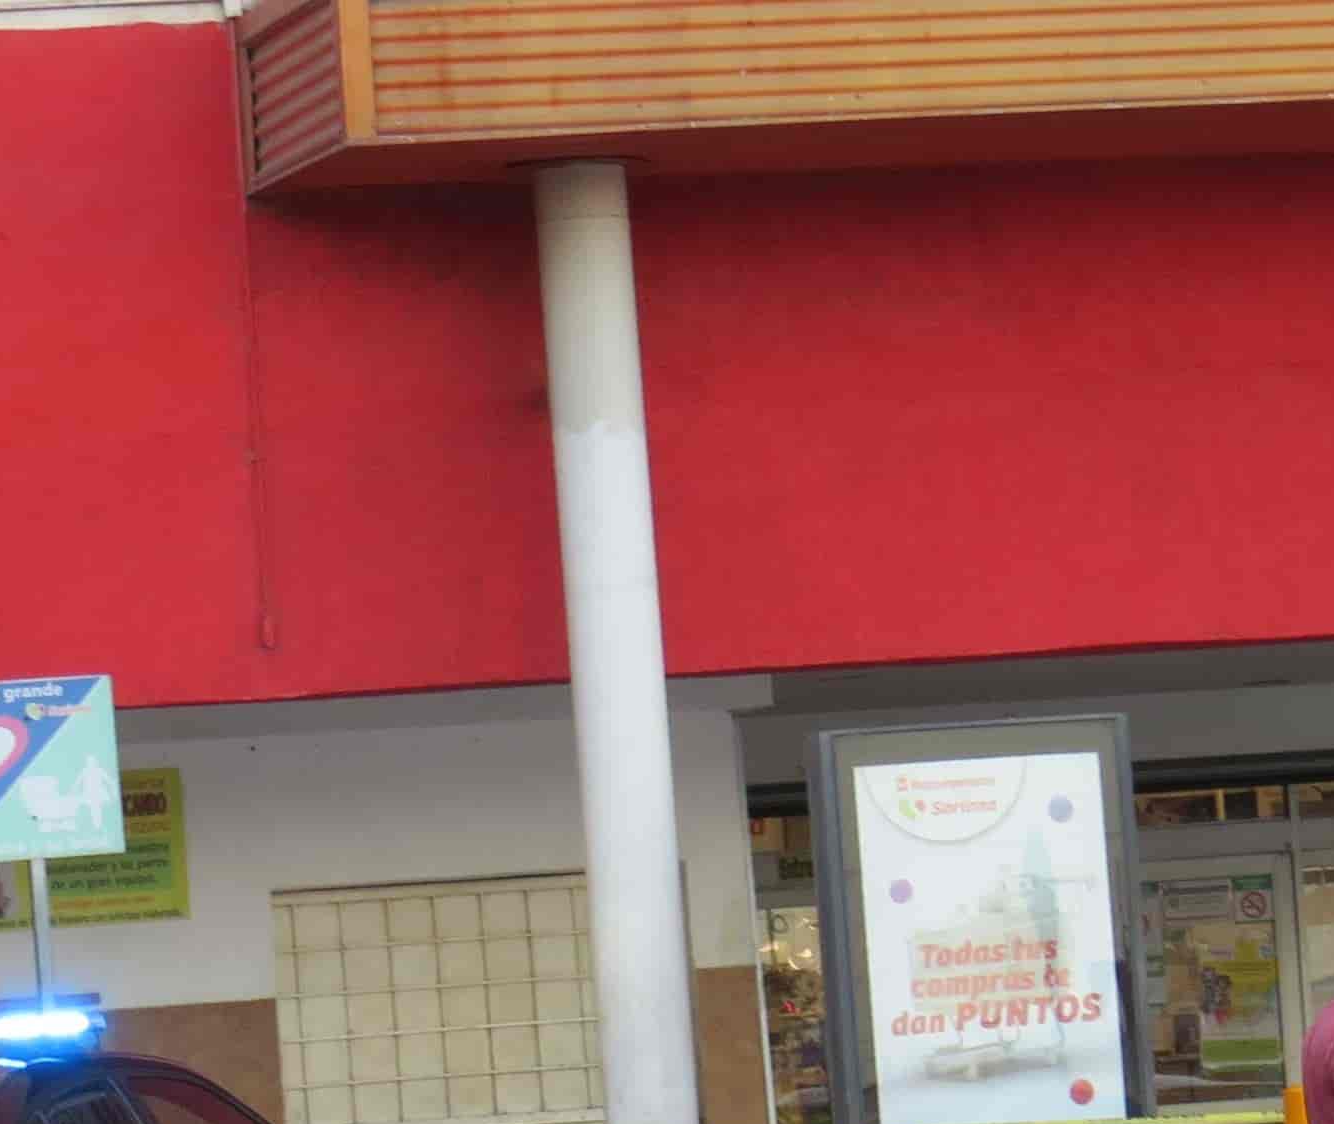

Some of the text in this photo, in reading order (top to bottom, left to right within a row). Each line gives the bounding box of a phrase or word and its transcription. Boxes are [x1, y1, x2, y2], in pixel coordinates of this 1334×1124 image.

[3, 682, 64, 702] grande
[921, 934, 1059, 968] Todas tus
[910, 963, 1071, 1000] compras te
[891, 992, 1103, 1036] dan PUNTOS
